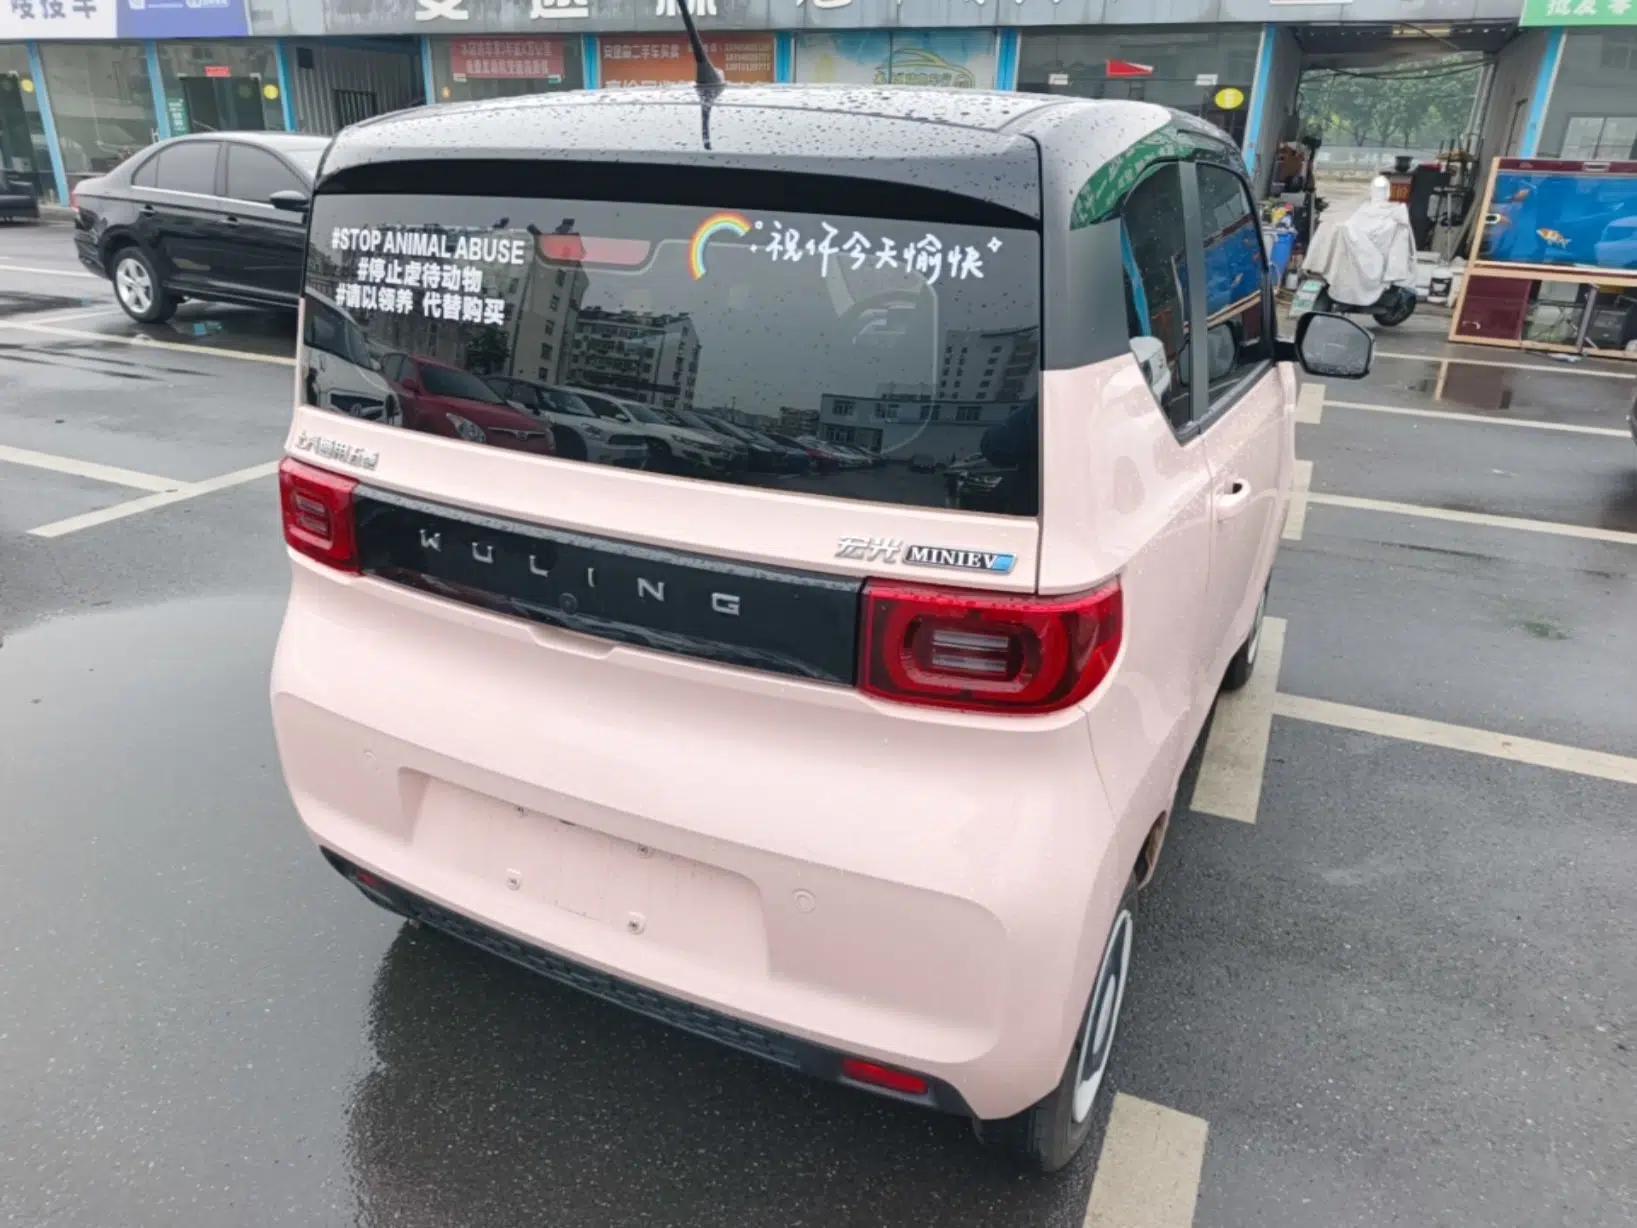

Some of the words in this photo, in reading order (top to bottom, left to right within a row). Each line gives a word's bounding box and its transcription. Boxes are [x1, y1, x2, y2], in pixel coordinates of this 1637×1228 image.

[332, 227, 380, 251] #STOP
[383, 231, 450, 257] ANIMAL
[454, 236, 525, 264] ABUSE
[357, 257, 483, 292] #停止虐待动物
[422, 291, 505, 325] 代替购买
[911, 547, 998, 568] MINIEV
